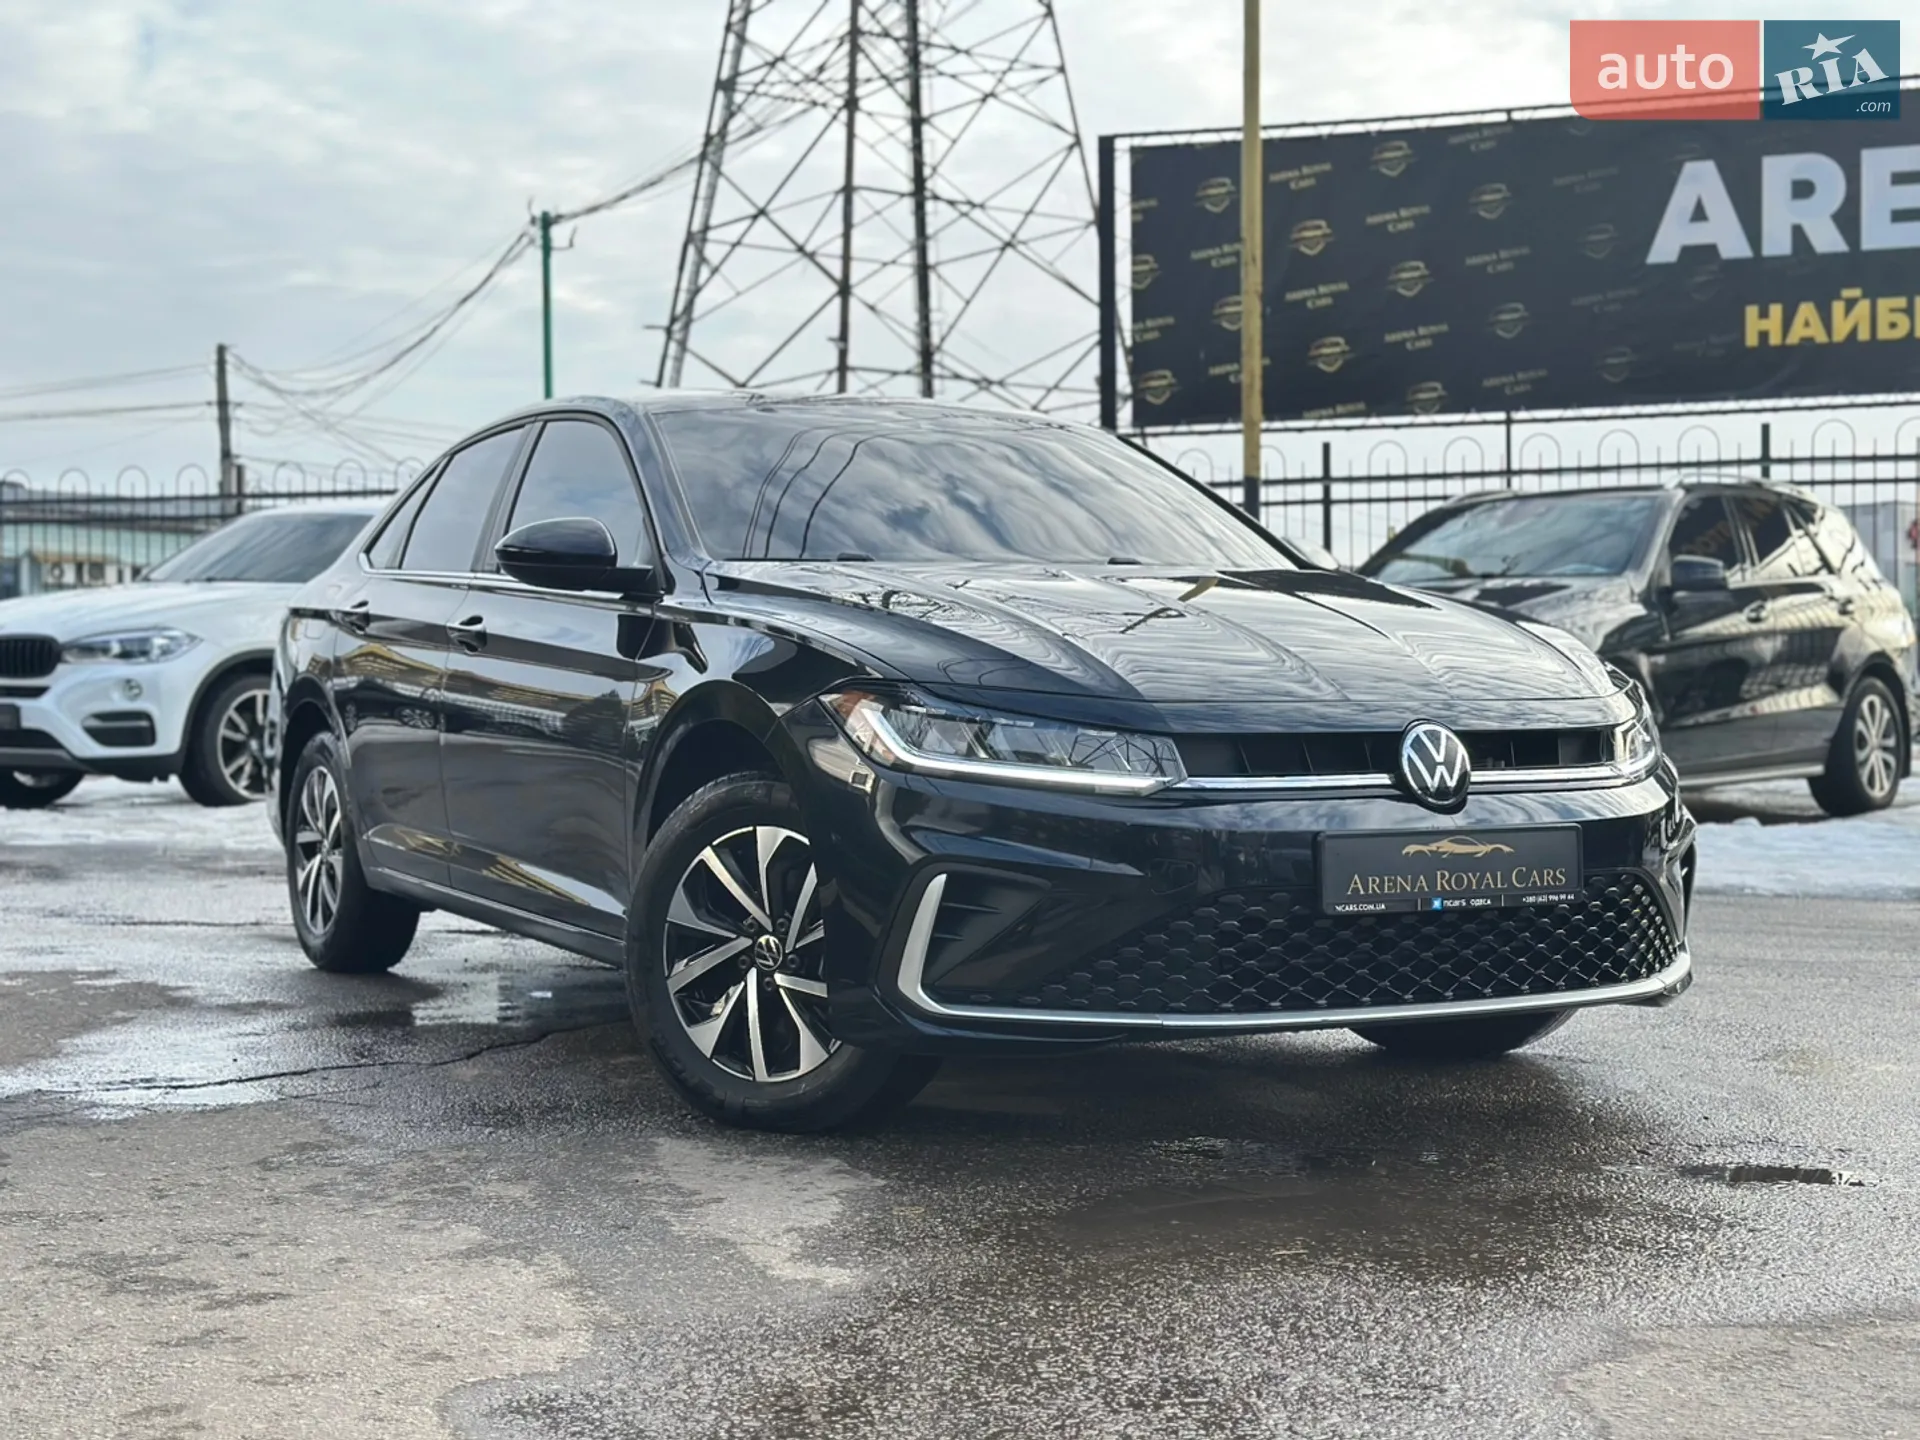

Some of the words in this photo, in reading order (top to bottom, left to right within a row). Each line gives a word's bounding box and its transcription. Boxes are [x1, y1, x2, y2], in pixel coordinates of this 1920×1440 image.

[1645, 144, 1920, 264] ARE
[1346, 874, 1430, 895] ARENA
[1436, 870, 1508, 892] ROYAL
[1512, 866, 1566, 888] CARS
